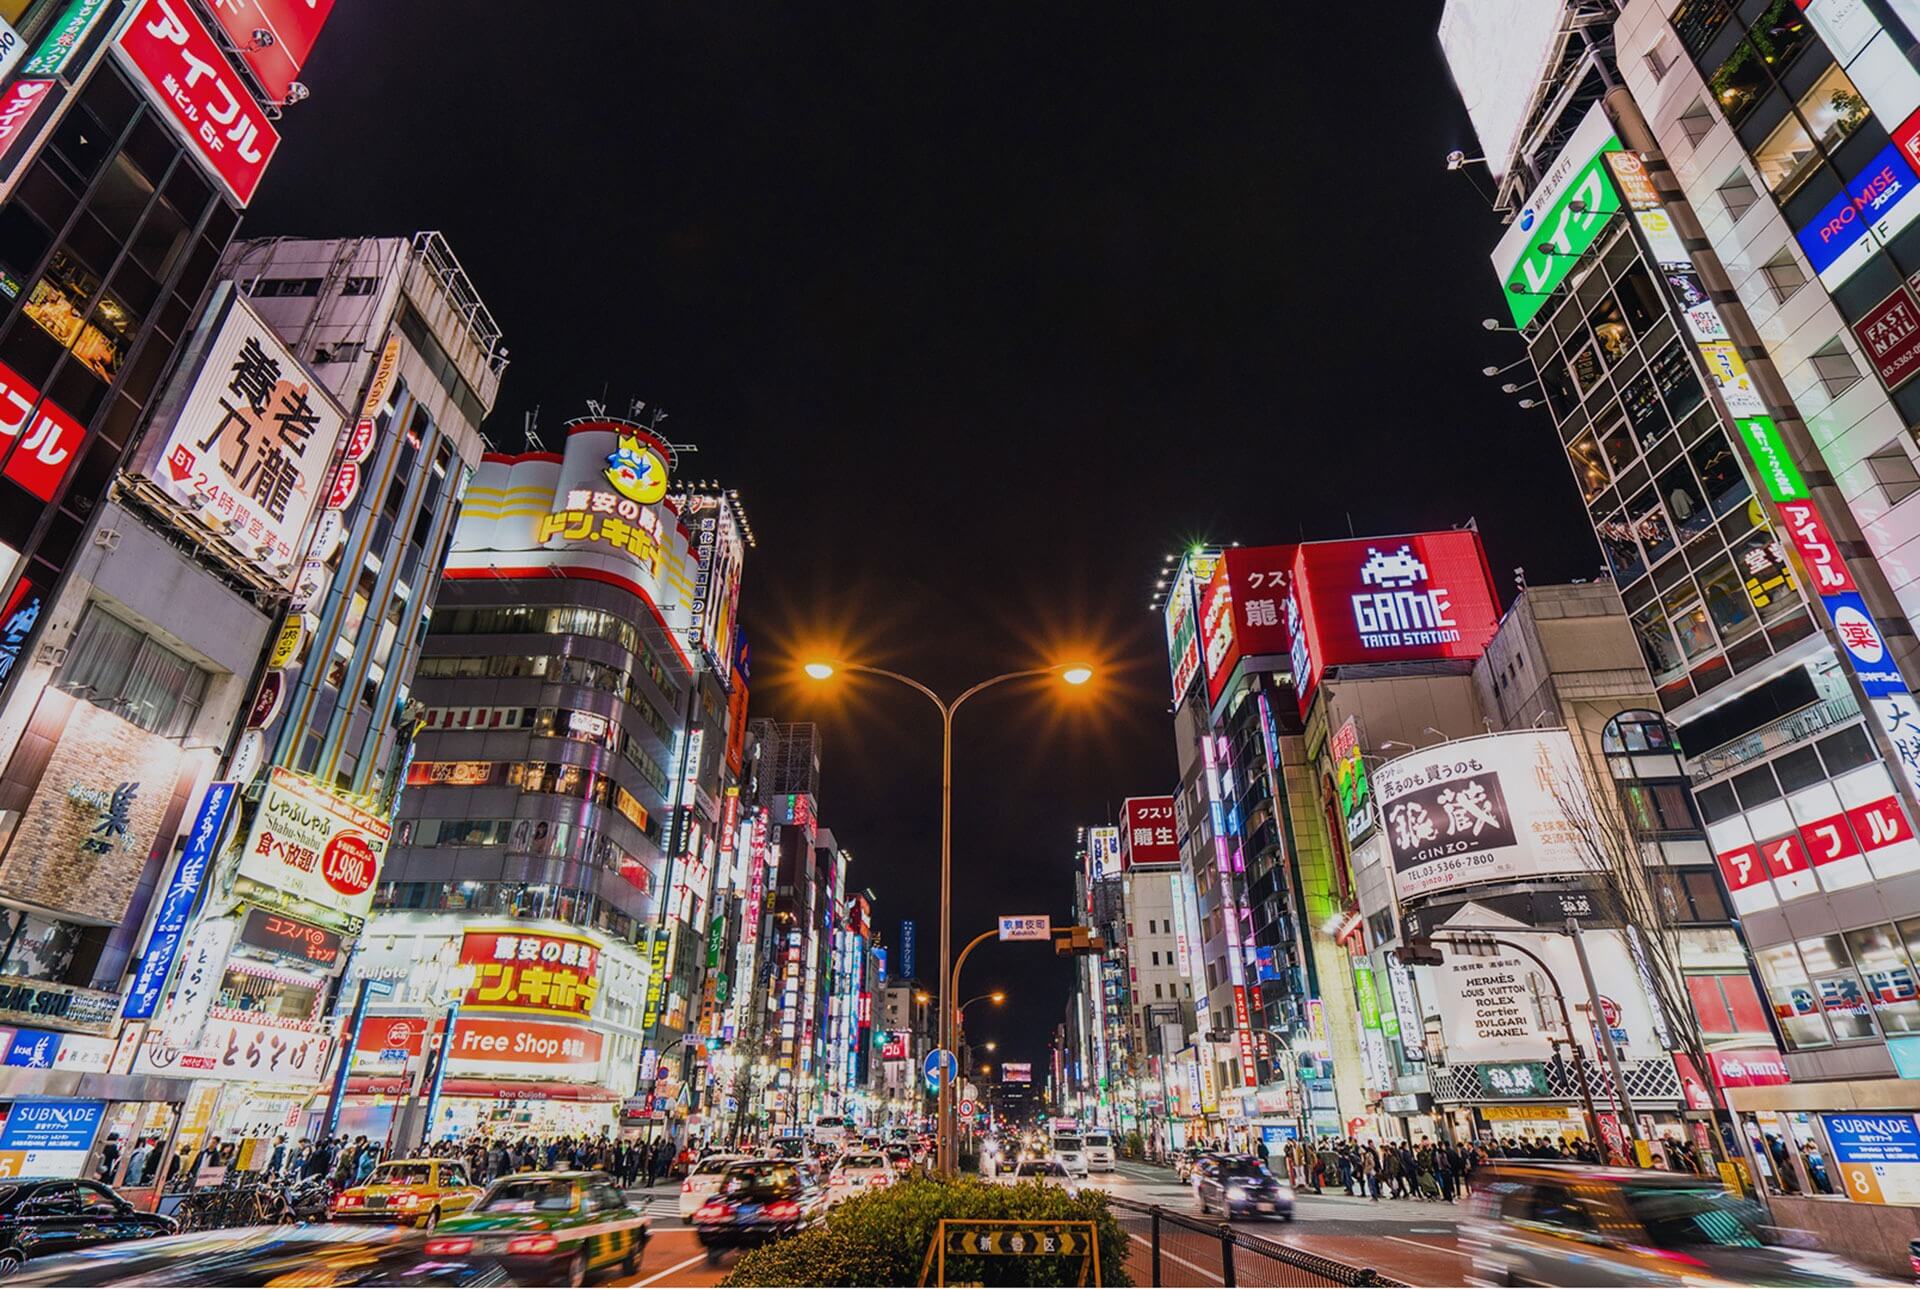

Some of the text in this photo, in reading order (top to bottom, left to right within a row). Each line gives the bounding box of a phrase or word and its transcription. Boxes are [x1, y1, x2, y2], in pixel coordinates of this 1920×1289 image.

[145, 0, 262, 164] アイフル
[200, 120, 224, 152] 6F
[1534, 156, 1572, 211] 新生銀行
[1870, 181, 1902, 210] プロミス
[1819, 166, 1897, 244] PROMISE
[1523, 168, 1602, 293] レイク
[1867, 304, 1906, 340] FAST
[1875, 320, 1915, 354] NAIL
[229, 335, 321, 458] 養老
[173, 449, 193, 473] B1
[566, 489, 663, 541] 驚安の殿
[1785, 506, 1845, 586] アイフル
[1352, 588, 1457, 633] GAME
[1360, 630, 1461, 648] TAITO STATION
[1839, 621, 1880, 649] 薬
[1137, 807, 1173, 820] クスリ
[1730, 808, 1899, 885] アイフル
[327, 850, 364, 888] 1,980
[355, 965, 409, 979] Quijote
[1461, 984, 1526, 998] LOUIS VUITTON
[1475, 996, 1515, 1007] ROLEX
[1475, 1017, 1528, 1028] BVLGARI
[1477, 1007, 1519, 1018] Cartier
[462, 1030, 509, 1052] Free
[514, 1031, 558, 1058] Shop
[1478, 1028, 1529, 1039] CHANEL
[222, 1027, 315, 1073] とらそば
[499, 1089, 547, 1099] Don Quijote
[17, 1107, 96, 1123] SUBNADE
[1832, 1118, 1911, 1136] SUBNADE
[1851, 1170, 1870, 1195] 8
